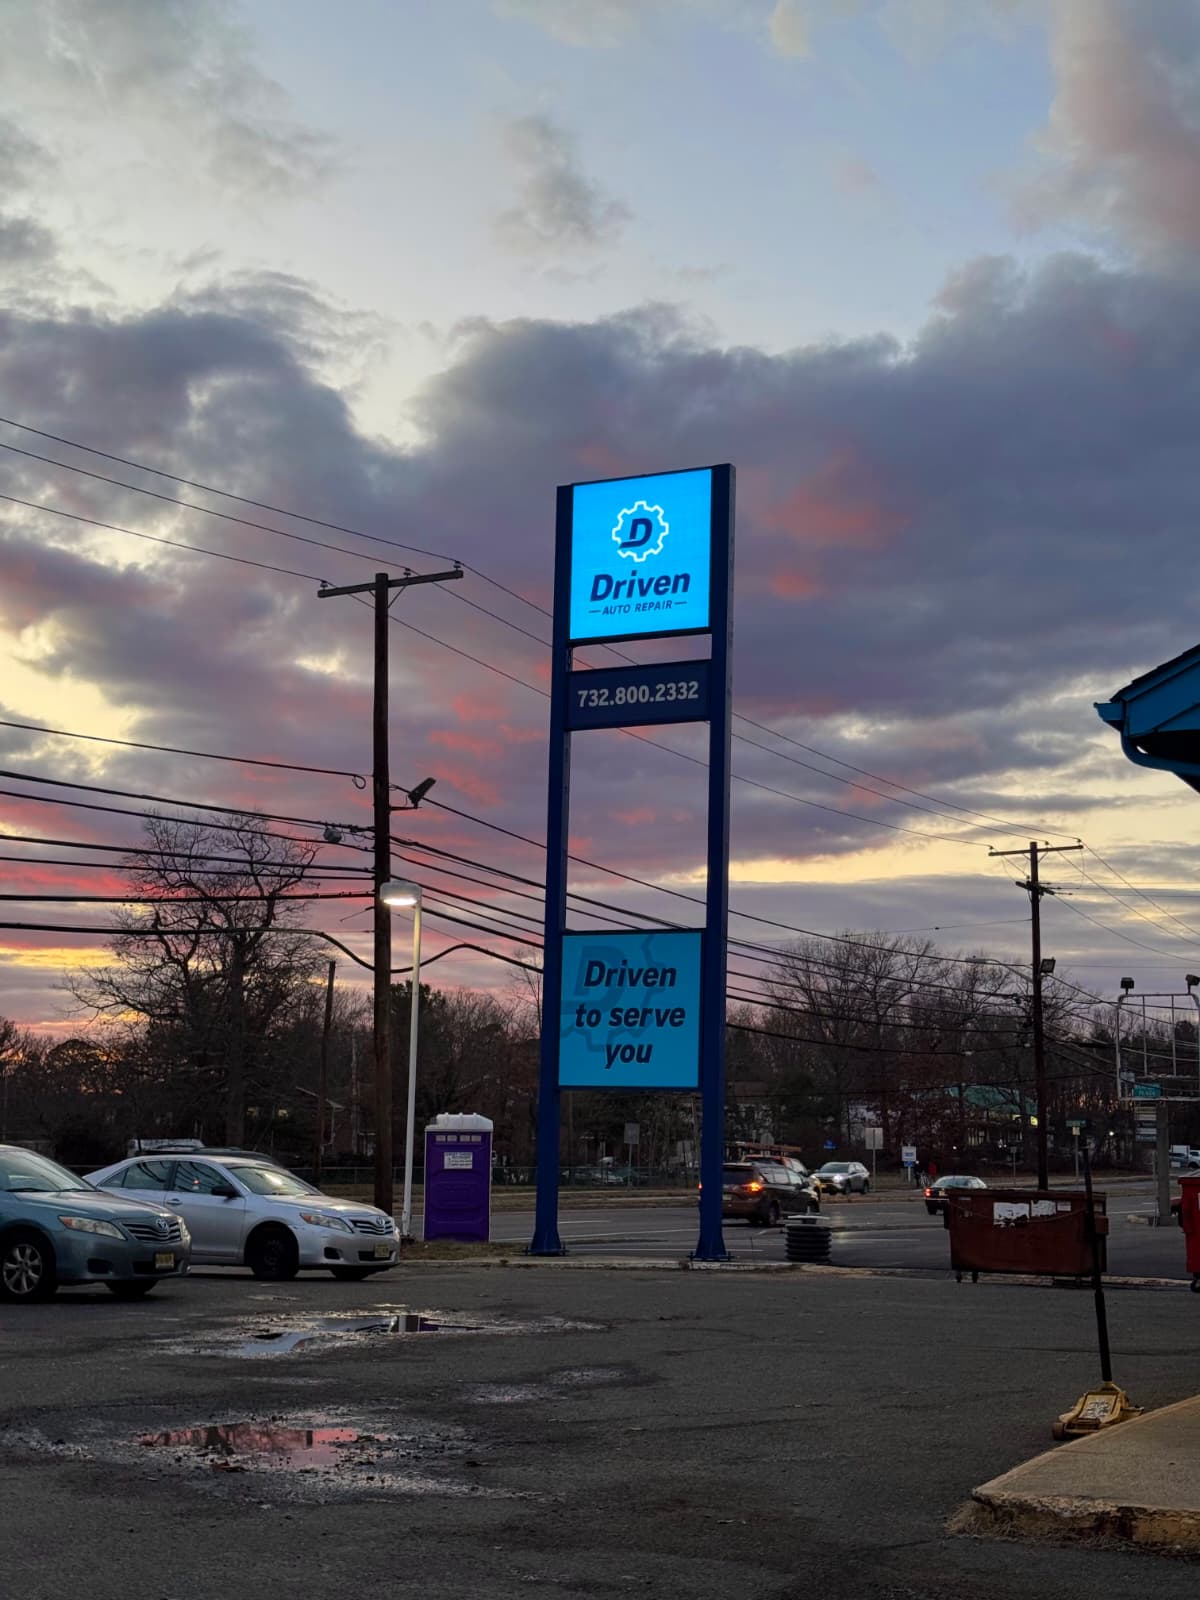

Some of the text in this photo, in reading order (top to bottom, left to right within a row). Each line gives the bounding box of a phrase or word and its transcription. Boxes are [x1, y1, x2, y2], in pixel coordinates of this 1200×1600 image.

[590, 570, 691, 601] Driven
[602, 600, 673, 616] AUTO REPAIR
[577, 681, 699, 708] 732.800.2332
[584, 959, 677, 987] Driven
[575, 1003, 686, 1028] to serve
[605, 1043, 653, 1070] you
